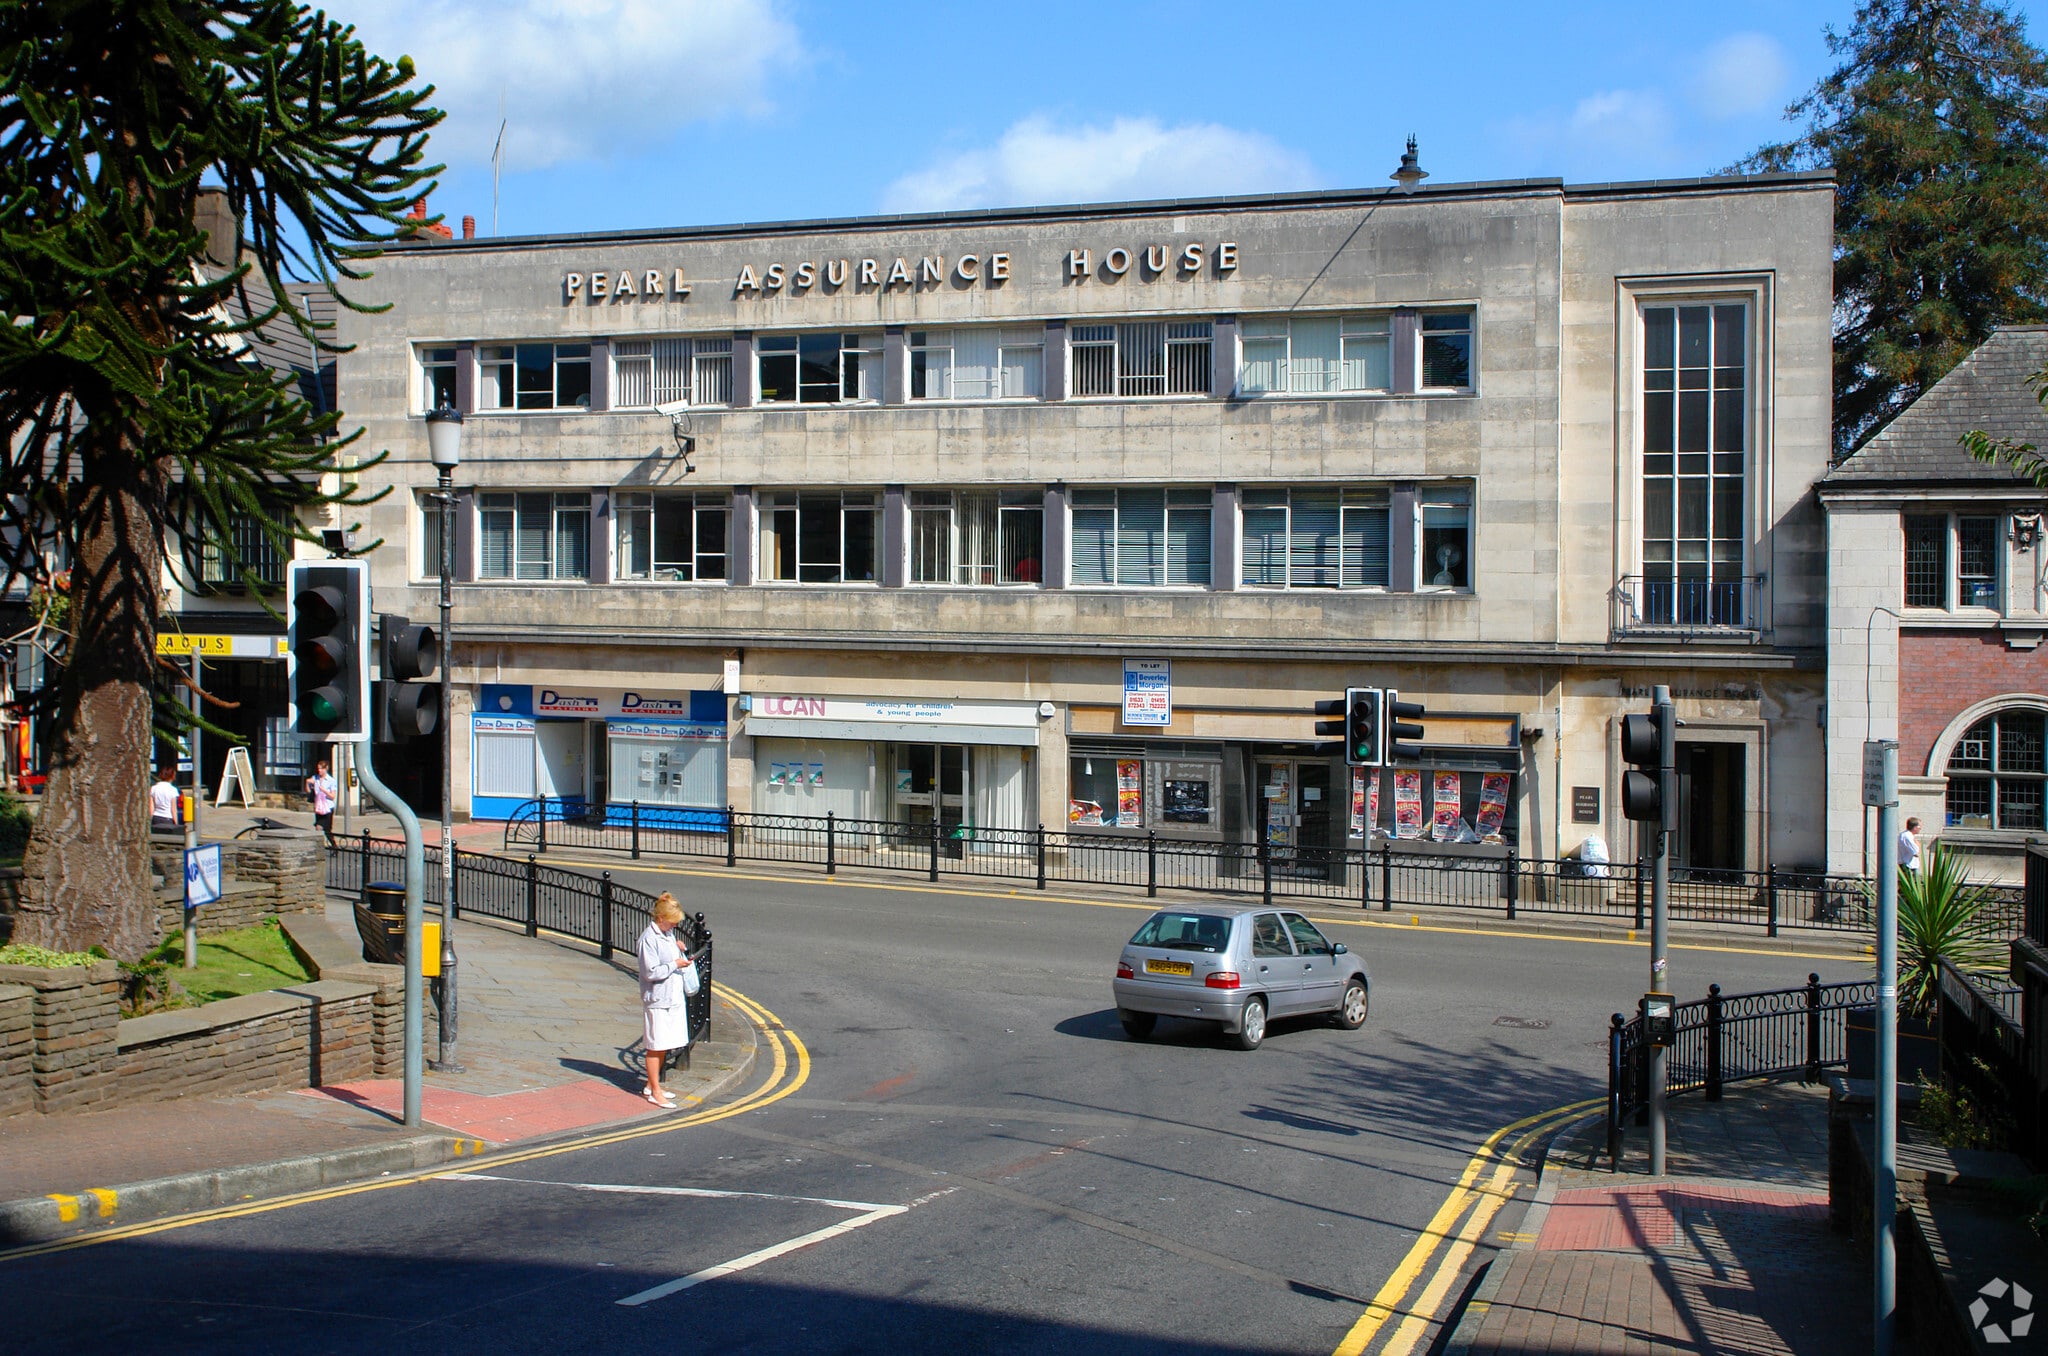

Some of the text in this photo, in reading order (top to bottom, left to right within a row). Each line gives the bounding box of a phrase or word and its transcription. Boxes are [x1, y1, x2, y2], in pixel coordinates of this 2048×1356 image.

[566, 242, 1238, 298] PEARL ASSURANCE HOUSE
[165, 636, 224, 649] ACUS
[1138, 673, 1168, 682] Beverley
[540, 690, 580, 706] Dash
[622, 692, 663, 709] Dash
[865, 701, 902, 709] advocacy
[763, 695, 826, 717] UCAN
[915, 710, 942, 718] people
